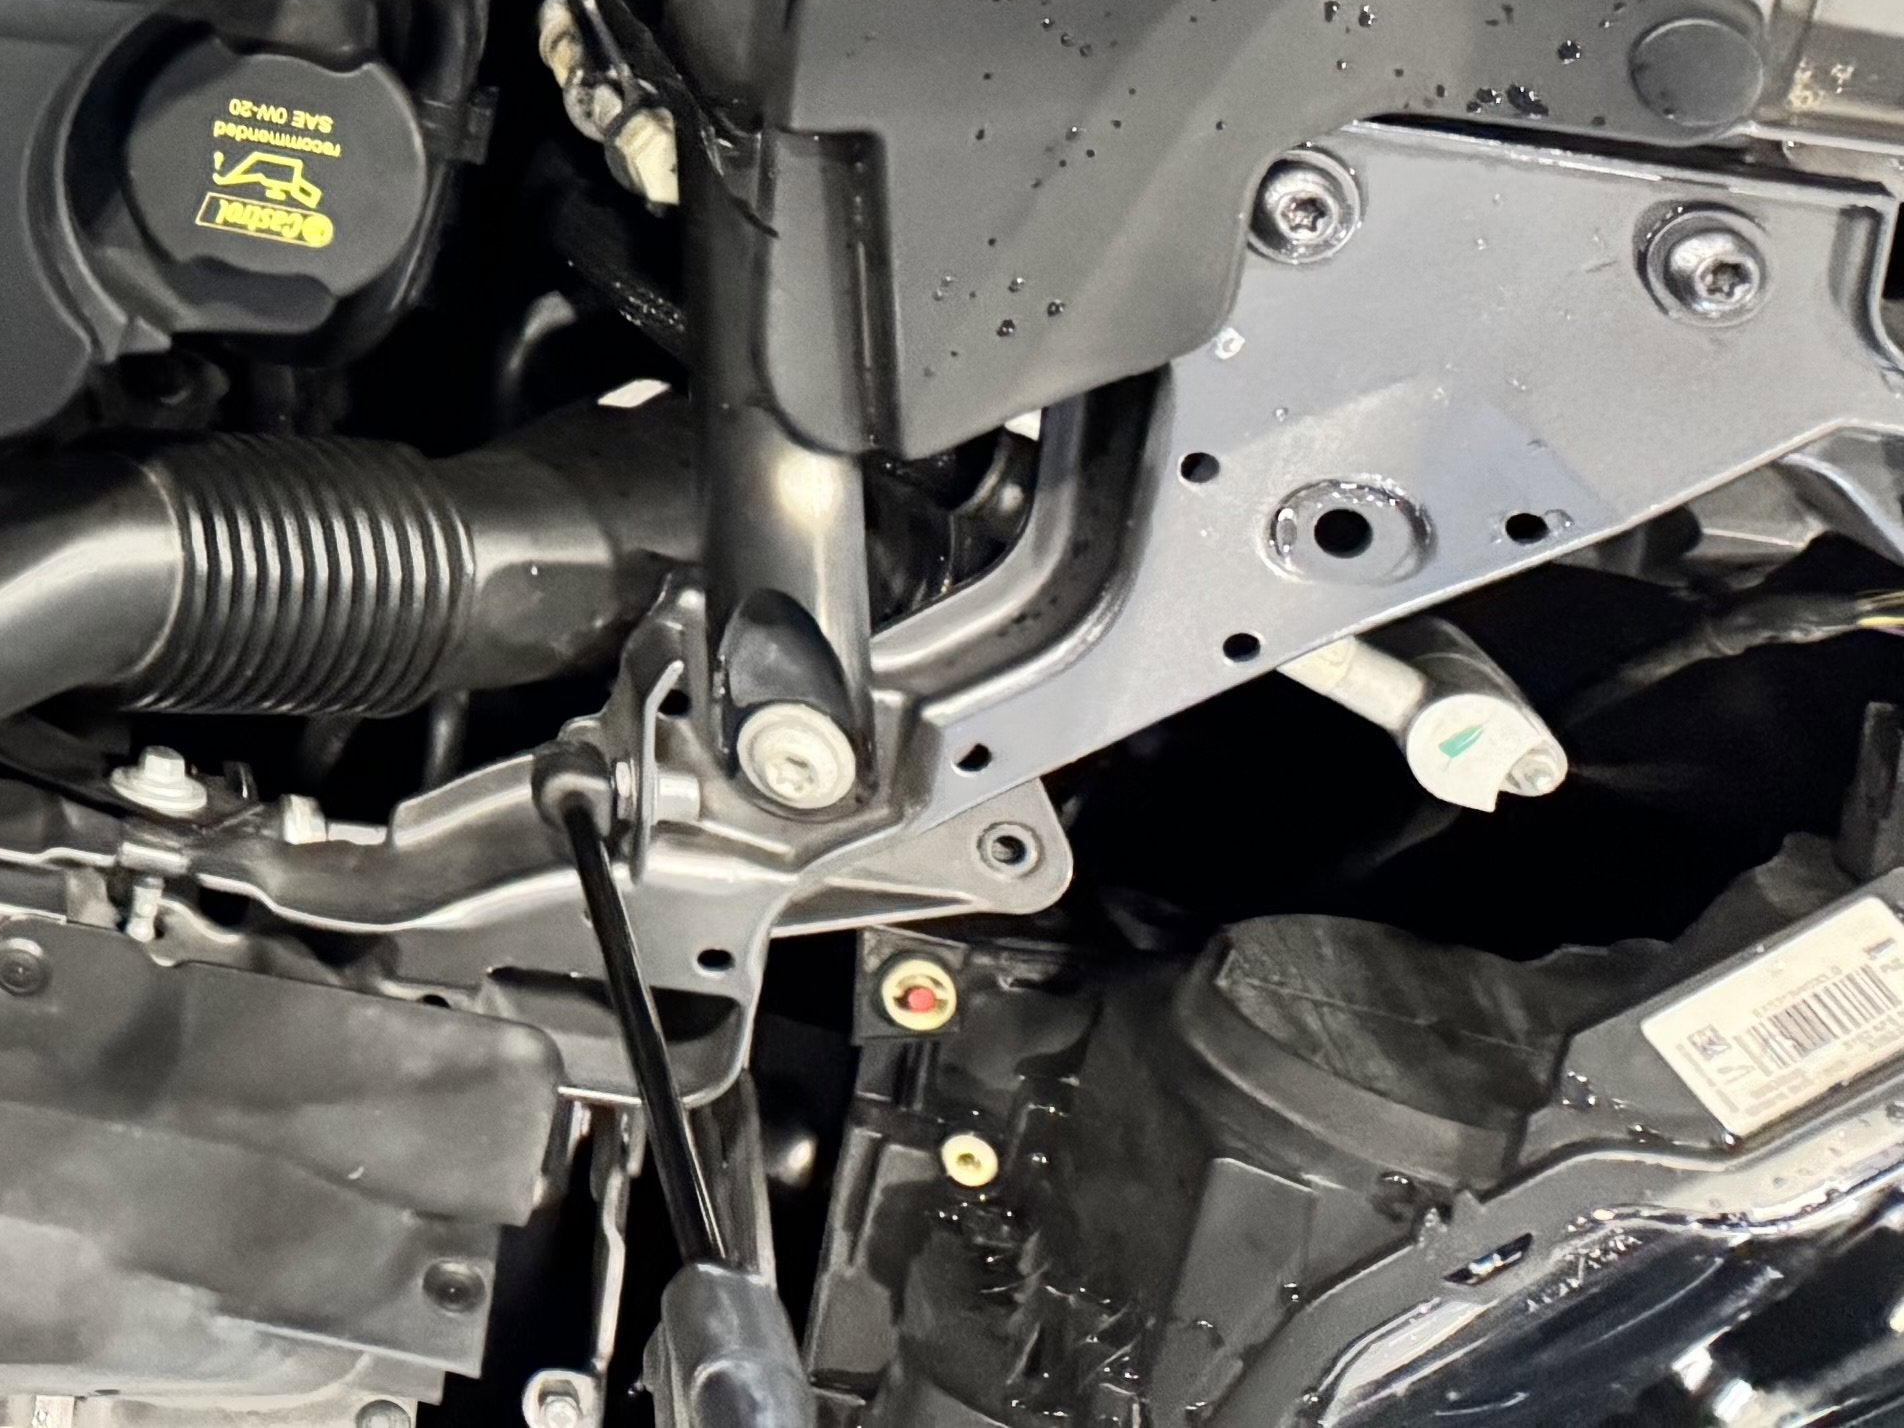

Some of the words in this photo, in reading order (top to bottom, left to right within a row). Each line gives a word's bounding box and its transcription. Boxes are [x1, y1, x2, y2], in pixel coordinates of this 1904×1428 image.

[228, 97, 289, 125] 0W-20
[292, 108, 334, 134] SAE
[212, 119, 342, 157] recommended
[215, 198, 303, 239] Castrol
